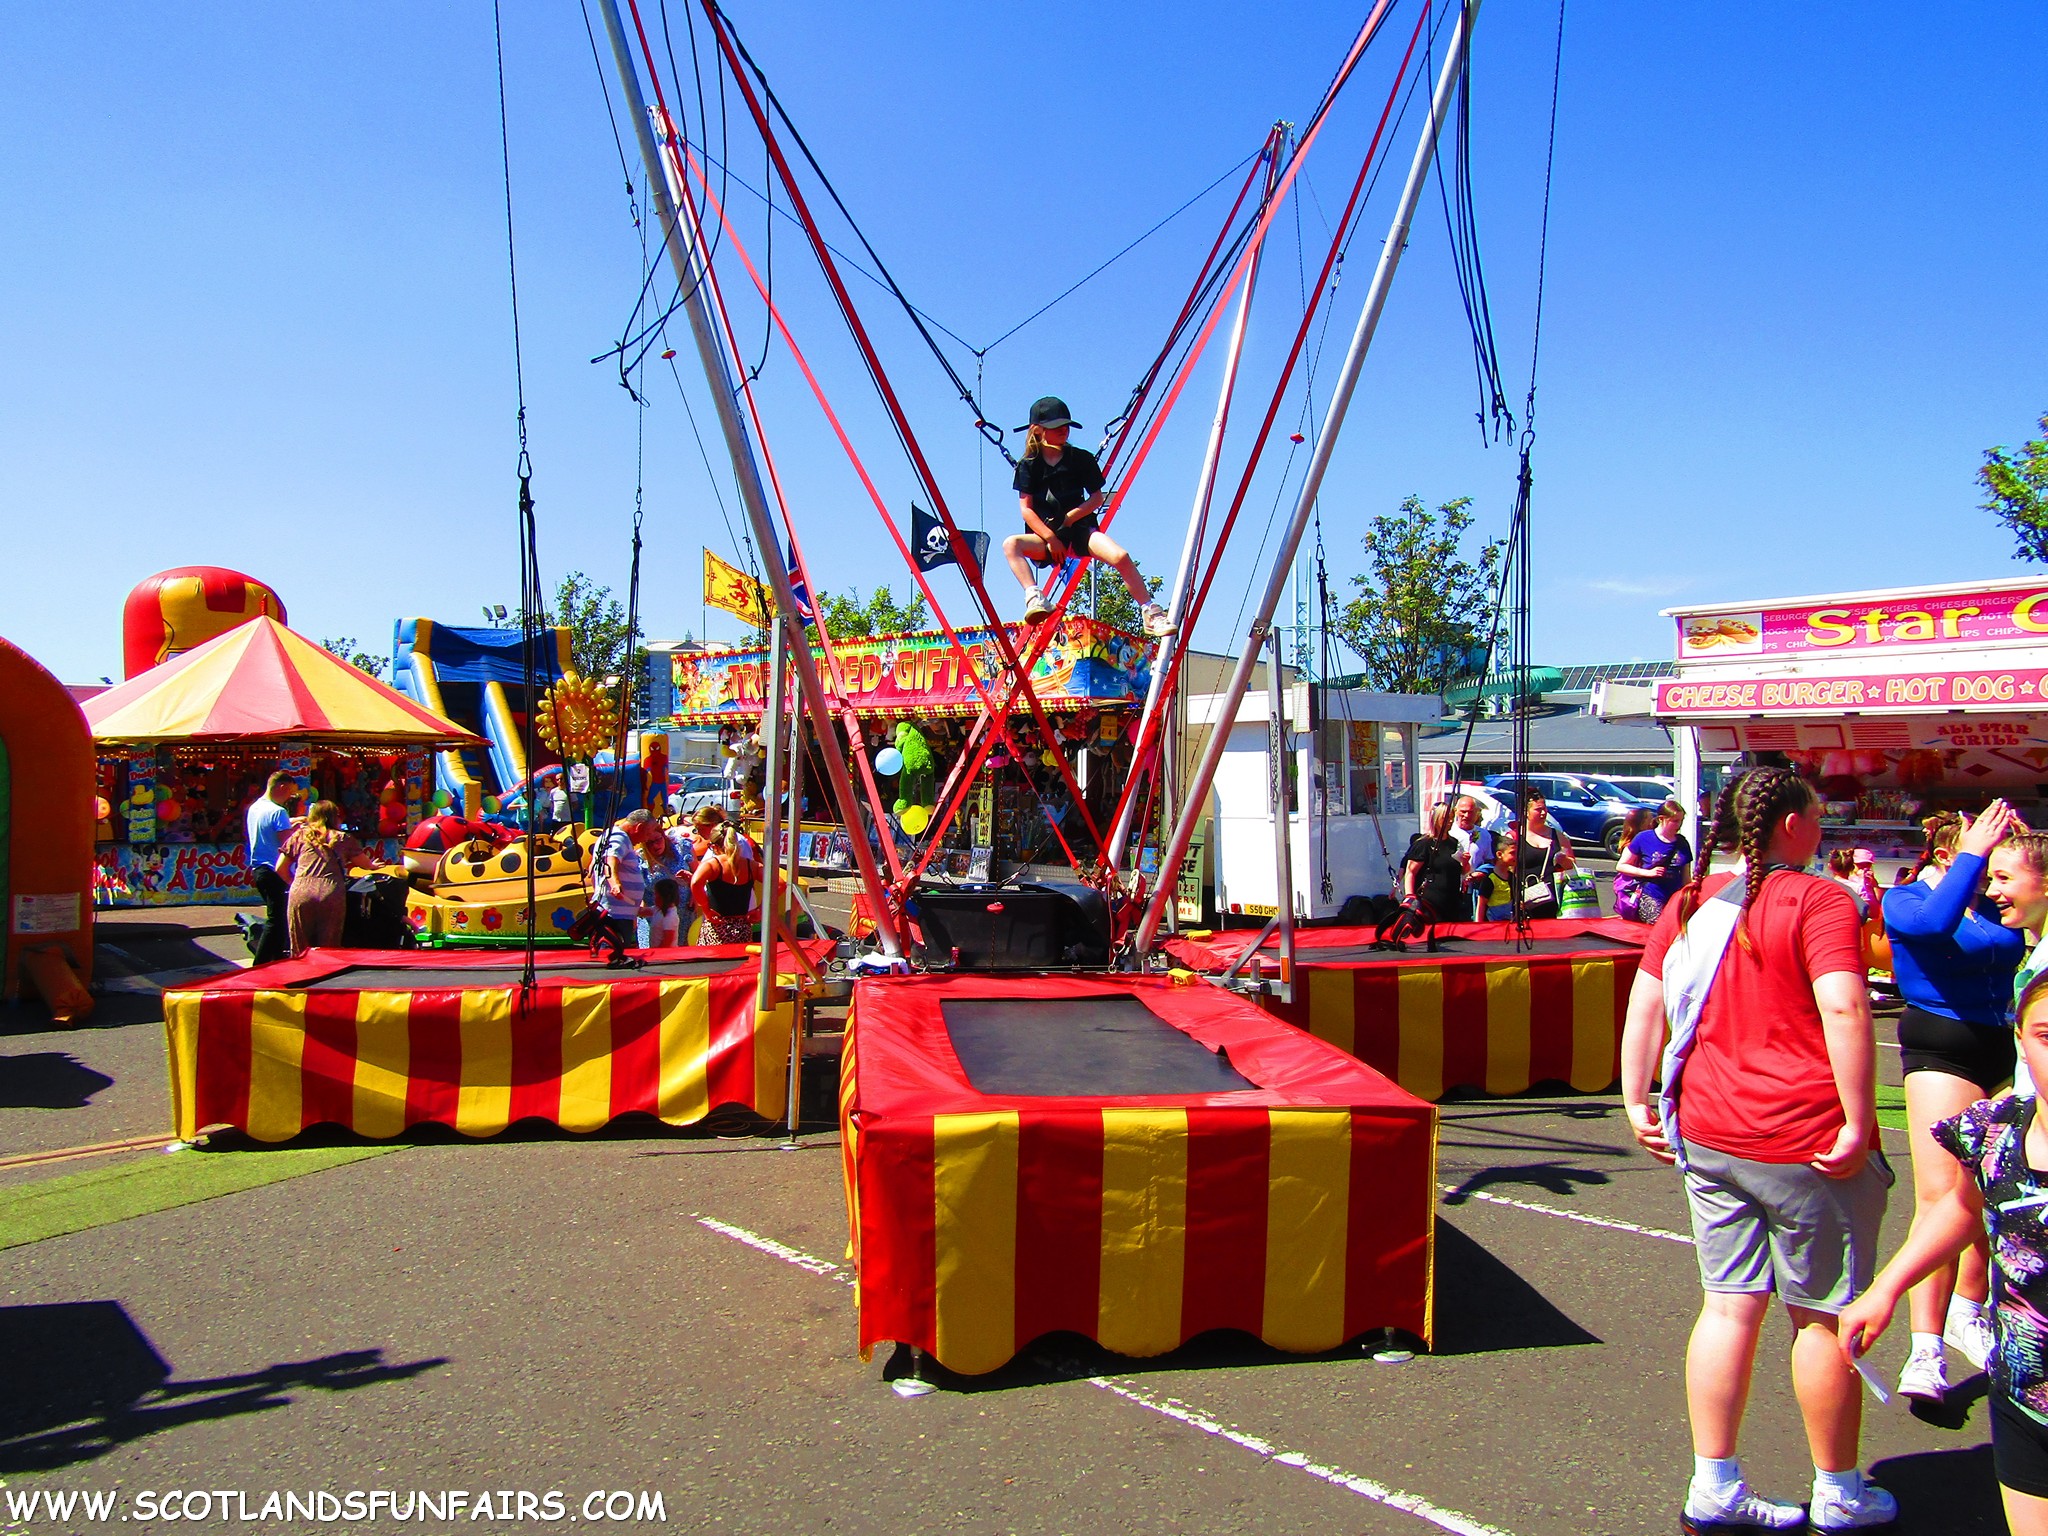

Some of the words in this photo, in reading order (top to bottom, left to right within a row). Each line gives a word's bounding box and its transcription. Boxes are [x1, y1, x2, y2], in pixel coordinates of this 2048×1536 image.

[1924, 596, 2022, 610] CHEESEBURGERS
[1804, 605, 1980, 646] Star
[1986, 627, 2023, 636] CHIPS
[894, 643, 982, 693] GIFTS
[1666, 684, 1758, 708] CHEESE
[1762, 680, 1864, 706] BURGER
[1885, 677, 1946, 703] HOT
[1952, 675, 2014, 701] DOG
[1937, 724, 1973, 736] ALL
[1978, 722, 2029, 735] STAR
[1951, 734, 2020, 746] GRILL
[175, 844, 247, 870] Hook
[167, 868, 189, 892] A
